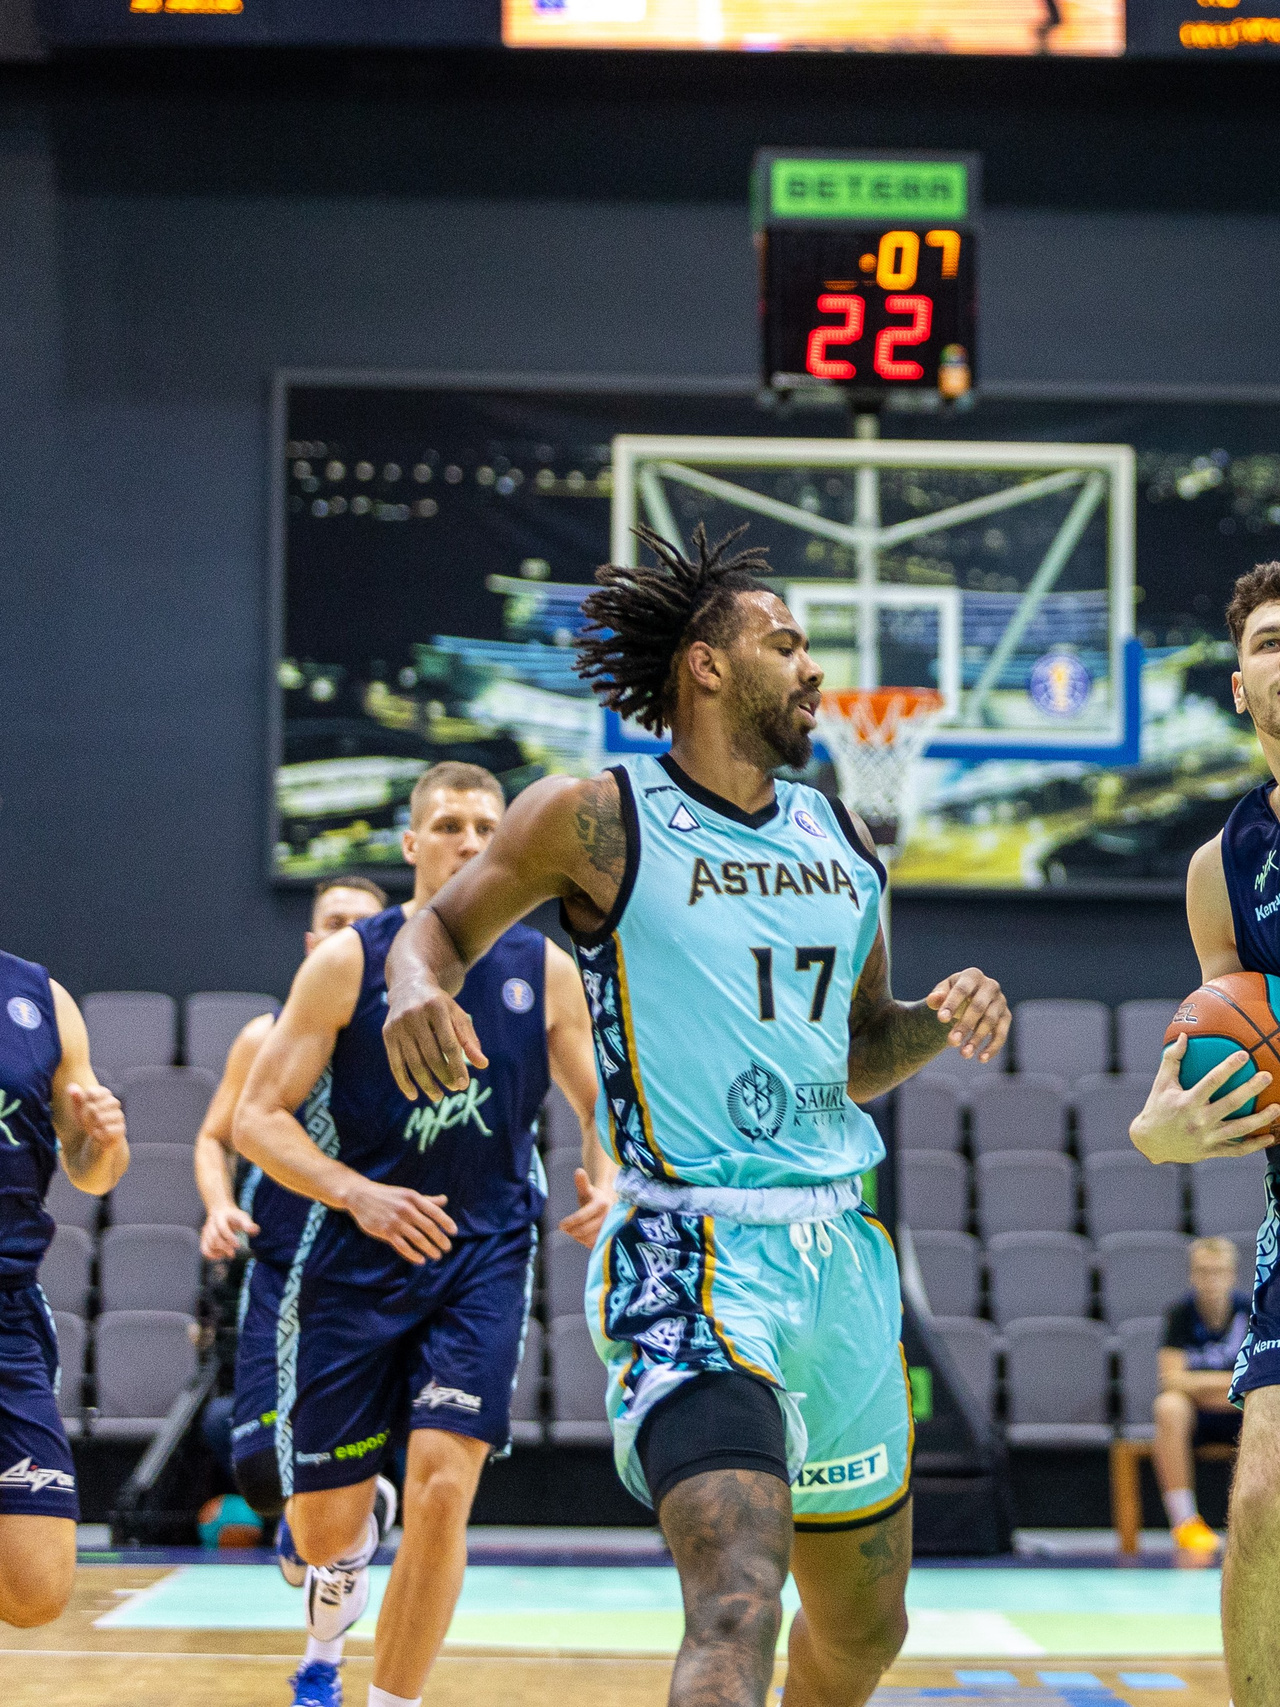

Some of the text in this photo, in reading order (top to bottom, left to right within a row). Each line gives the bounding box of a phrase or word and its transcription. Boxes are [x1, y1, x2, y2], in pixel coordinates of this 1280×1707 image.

[806, 294, 933, 380] 22
[687, 857, 860, 911] ASTANA
[749, 946, 837, 1022] 17
[797, 1452, 880, 1487] 1XBET
